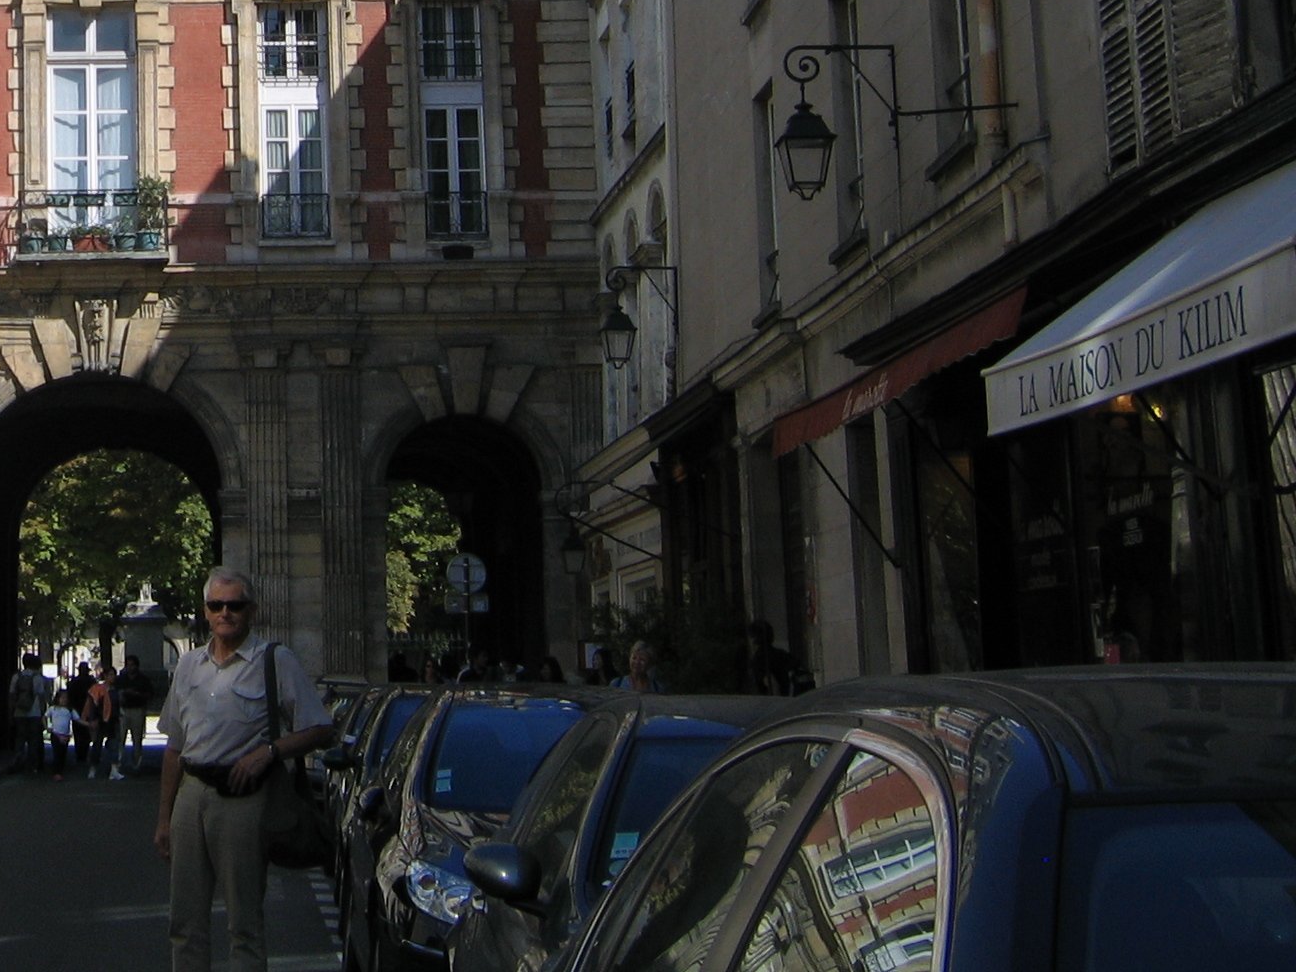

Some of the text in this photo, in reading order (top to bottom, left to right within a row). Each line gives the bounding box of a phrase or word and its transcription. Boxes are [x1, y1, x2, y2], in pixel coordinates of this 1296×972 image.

[1018, 285, 1248, 416] LA MAISON DU KILIM
